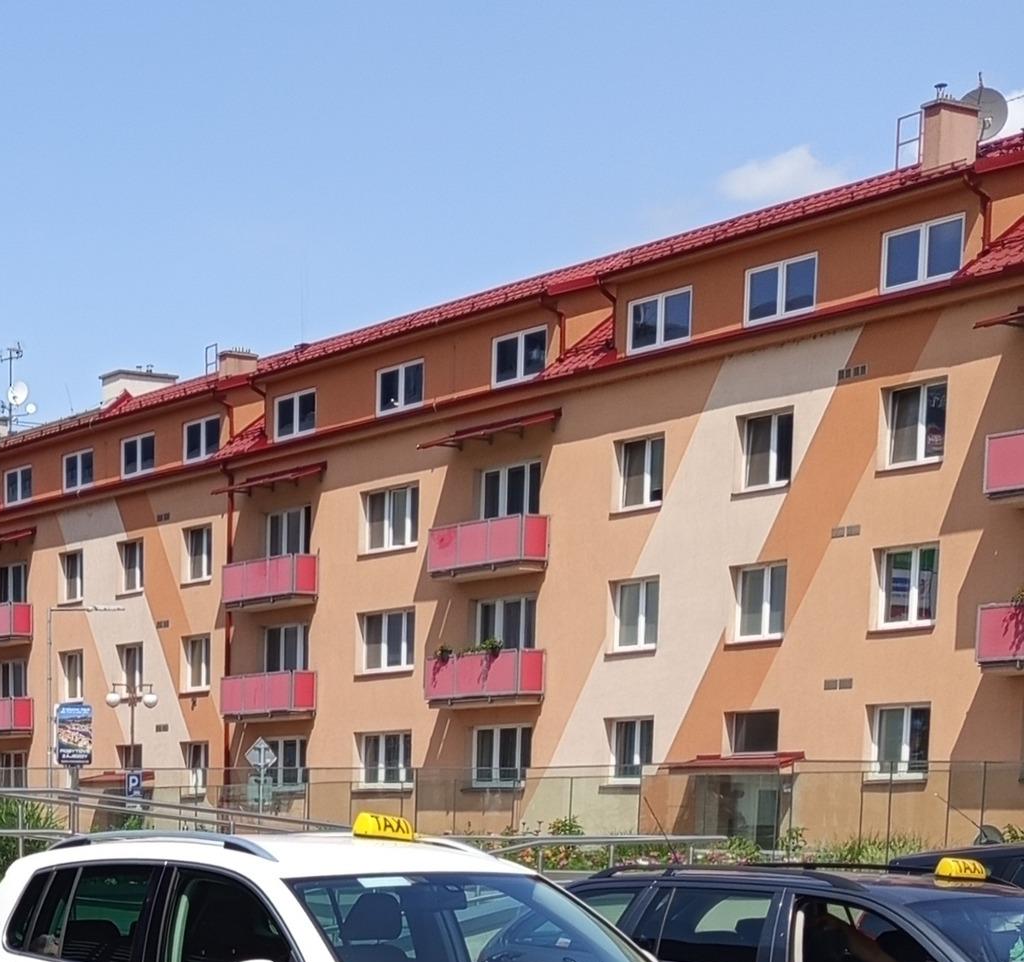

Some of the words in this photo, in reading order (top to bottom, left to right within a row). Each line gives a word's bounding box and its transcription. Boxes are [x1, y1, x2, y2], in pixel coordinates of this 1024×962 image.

[129, 775, 139, 792] P
[370, 815, 410, 834] TAXI
[952, 860, 984, 875] TAXI
